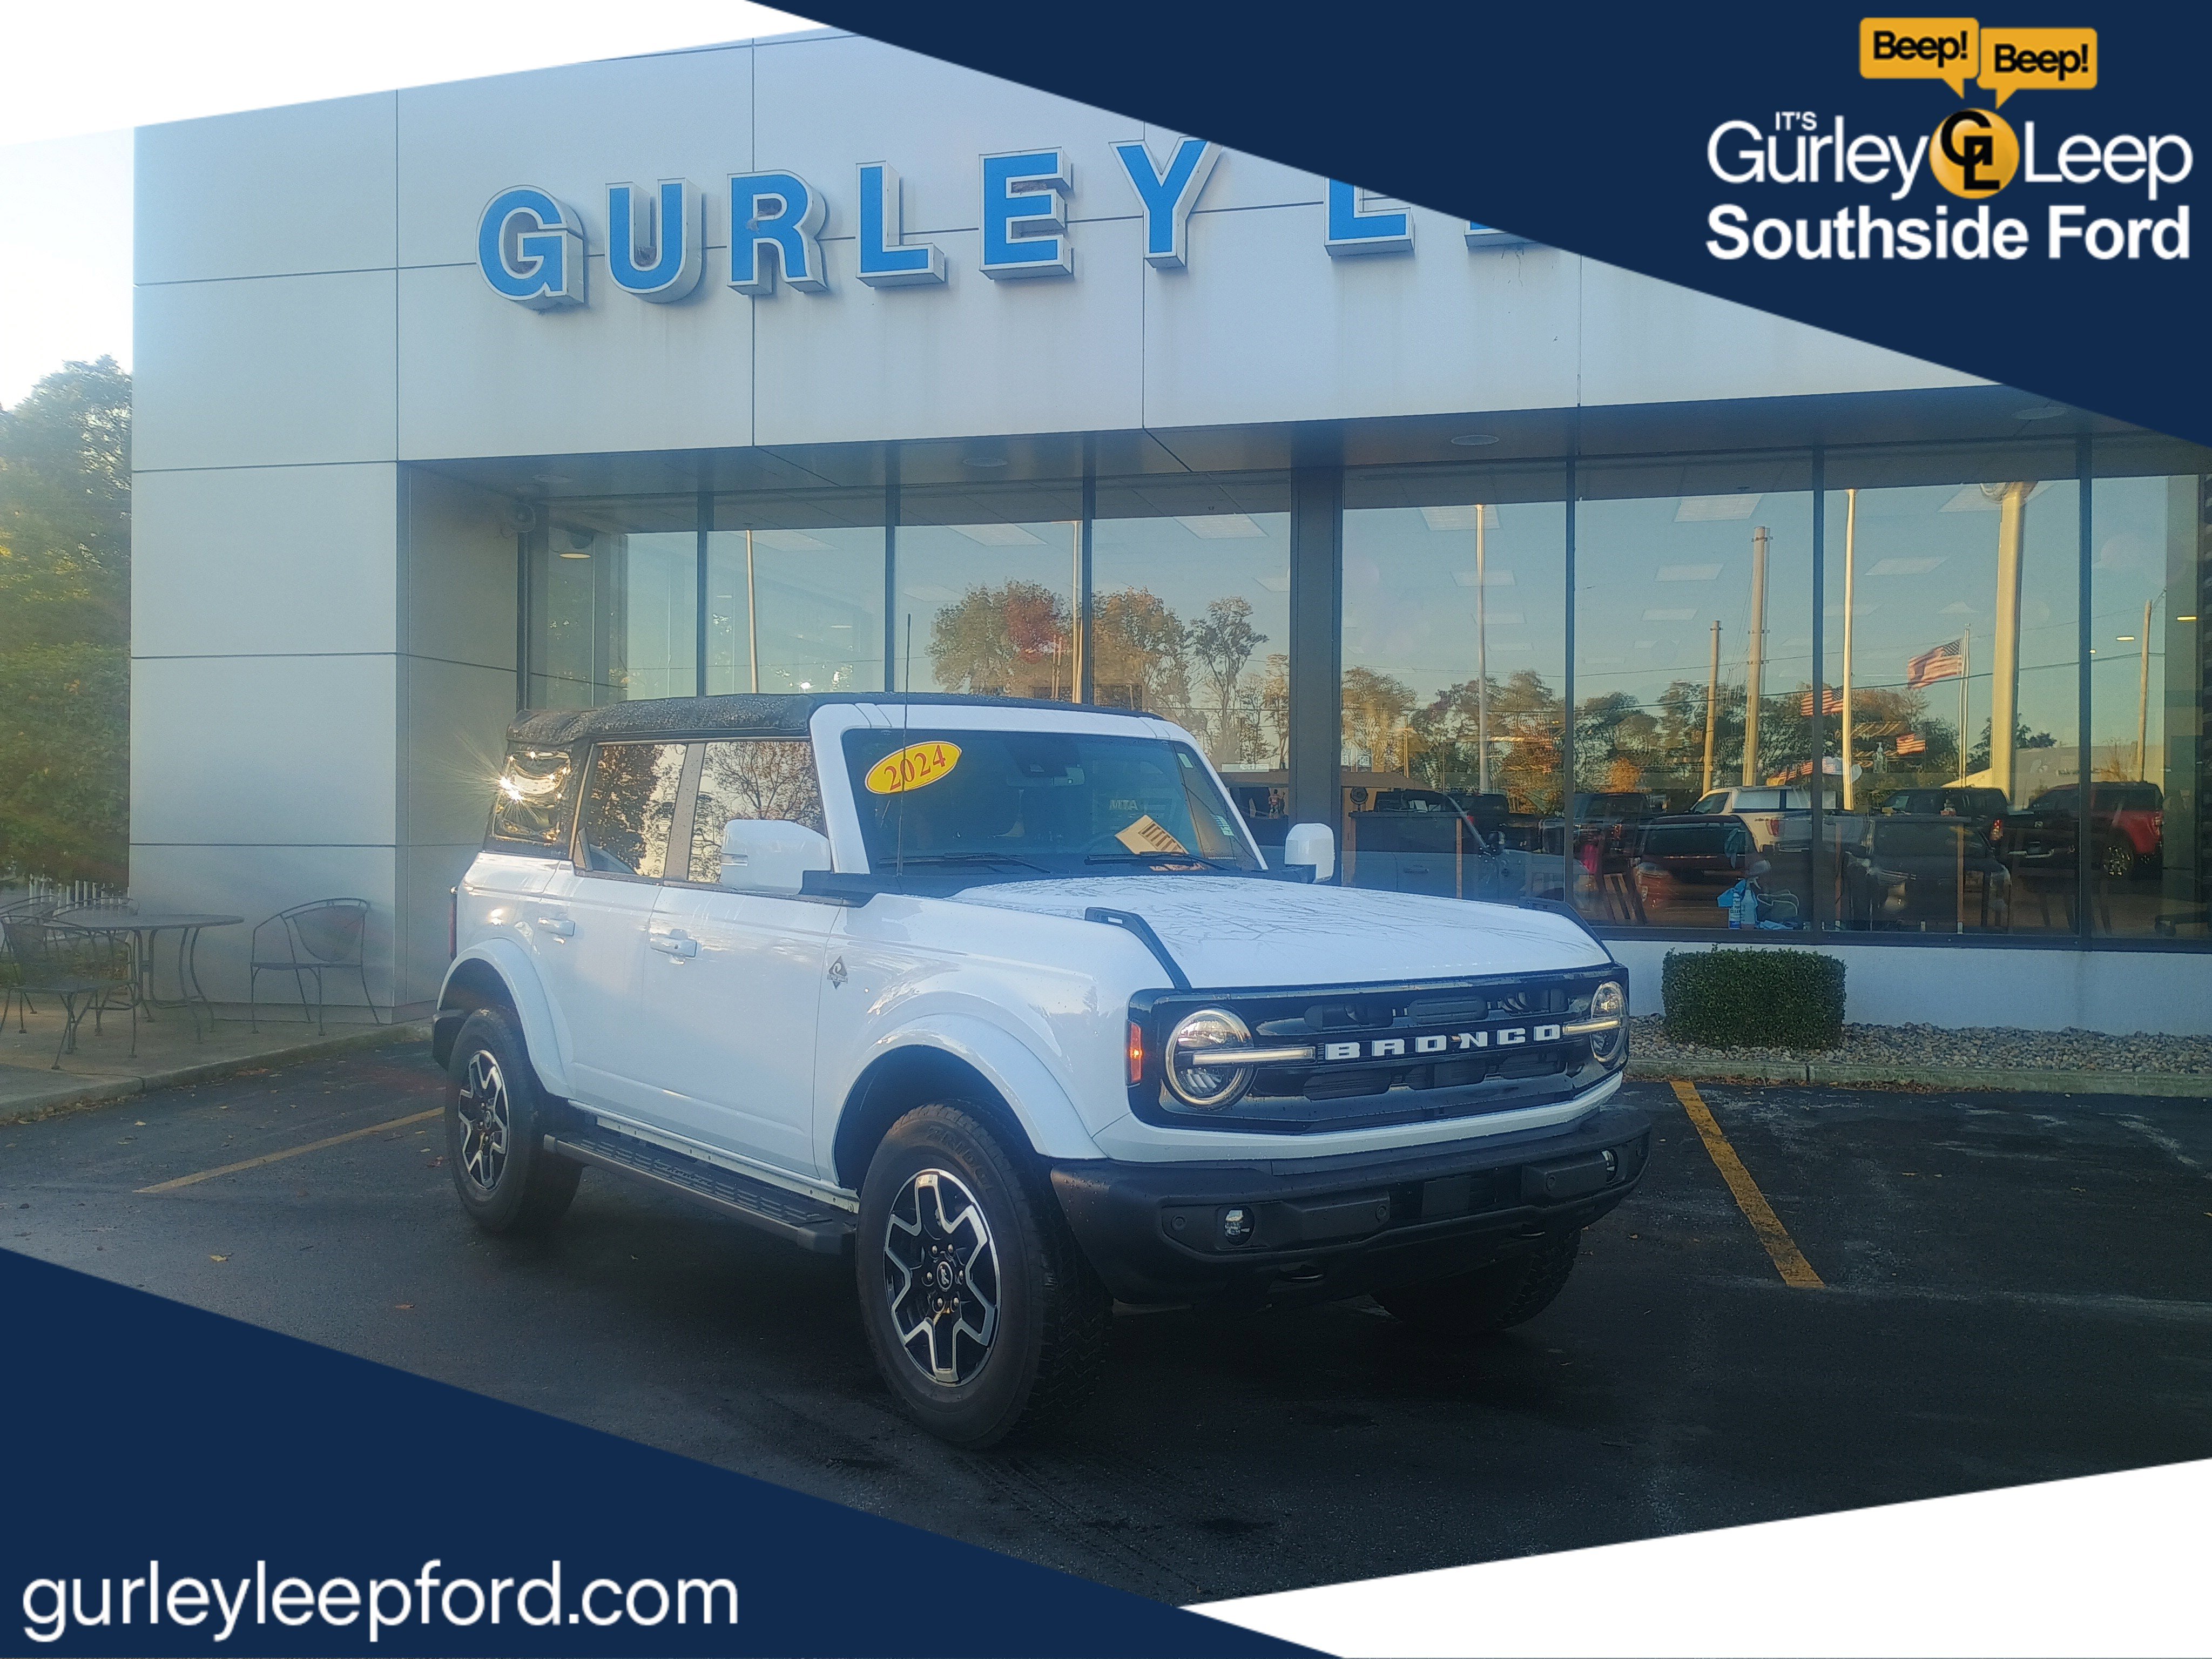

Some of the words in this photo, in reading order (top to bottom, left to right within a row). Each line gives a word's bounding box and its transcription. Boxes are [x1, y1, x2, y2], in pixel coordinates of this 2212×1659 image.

[475, 135, 1220, 310] GURLEY
[884, 744, 946, 791] 2024
[1324, 1024, 1561, 1061] BRONCO
